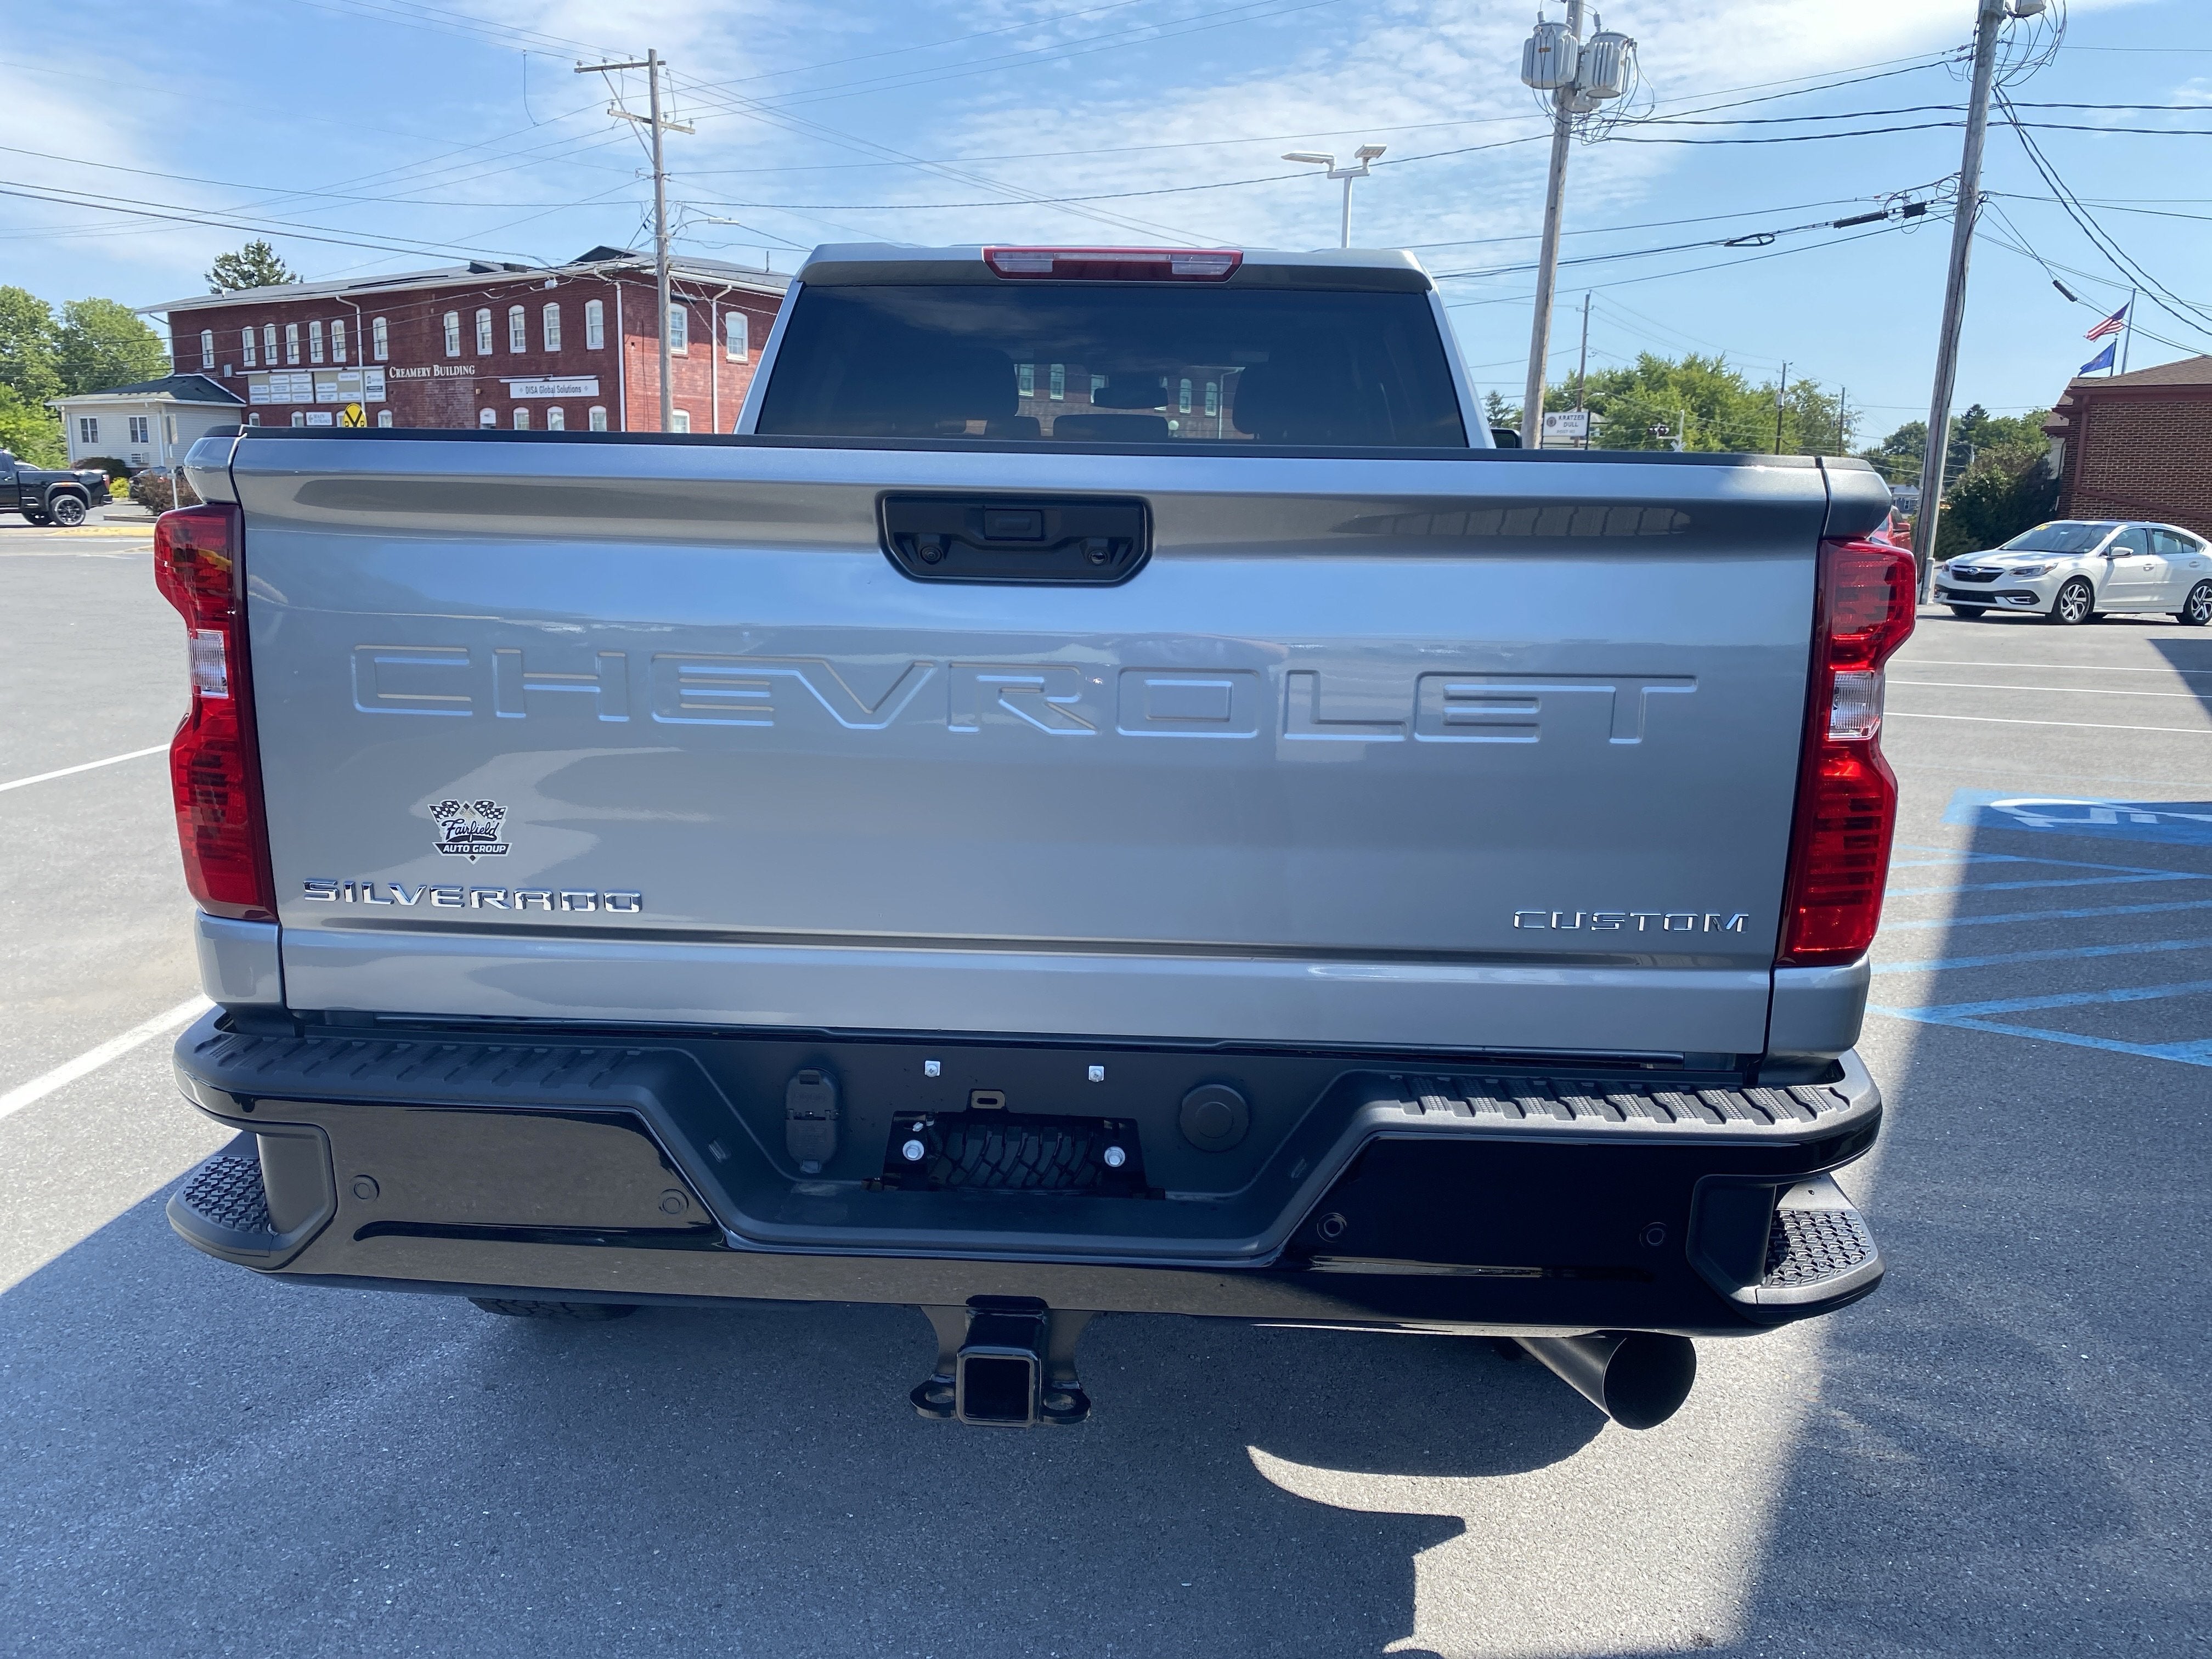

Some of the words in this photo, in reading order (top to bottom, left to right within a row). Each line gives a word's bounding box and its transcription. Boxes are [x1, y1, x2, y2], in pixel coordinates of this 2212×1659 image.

[389, 366, 431, 379] CREAMERY
[433, 364, 475, 376] BUILDING
[525, 386, 538, 394] DISA
[539, 385, 555, 394] Global
[557, 385, 582, 393] Solutions
[351, 644, 1698, 744] CHEVROLET
[441, 819, 500, 841] Fairfield
[443, 844, 470, 853] AUTO
[303, 878, 642, 913] SILVERADO
[1514, 909, 1750, 933] CUSTOM
